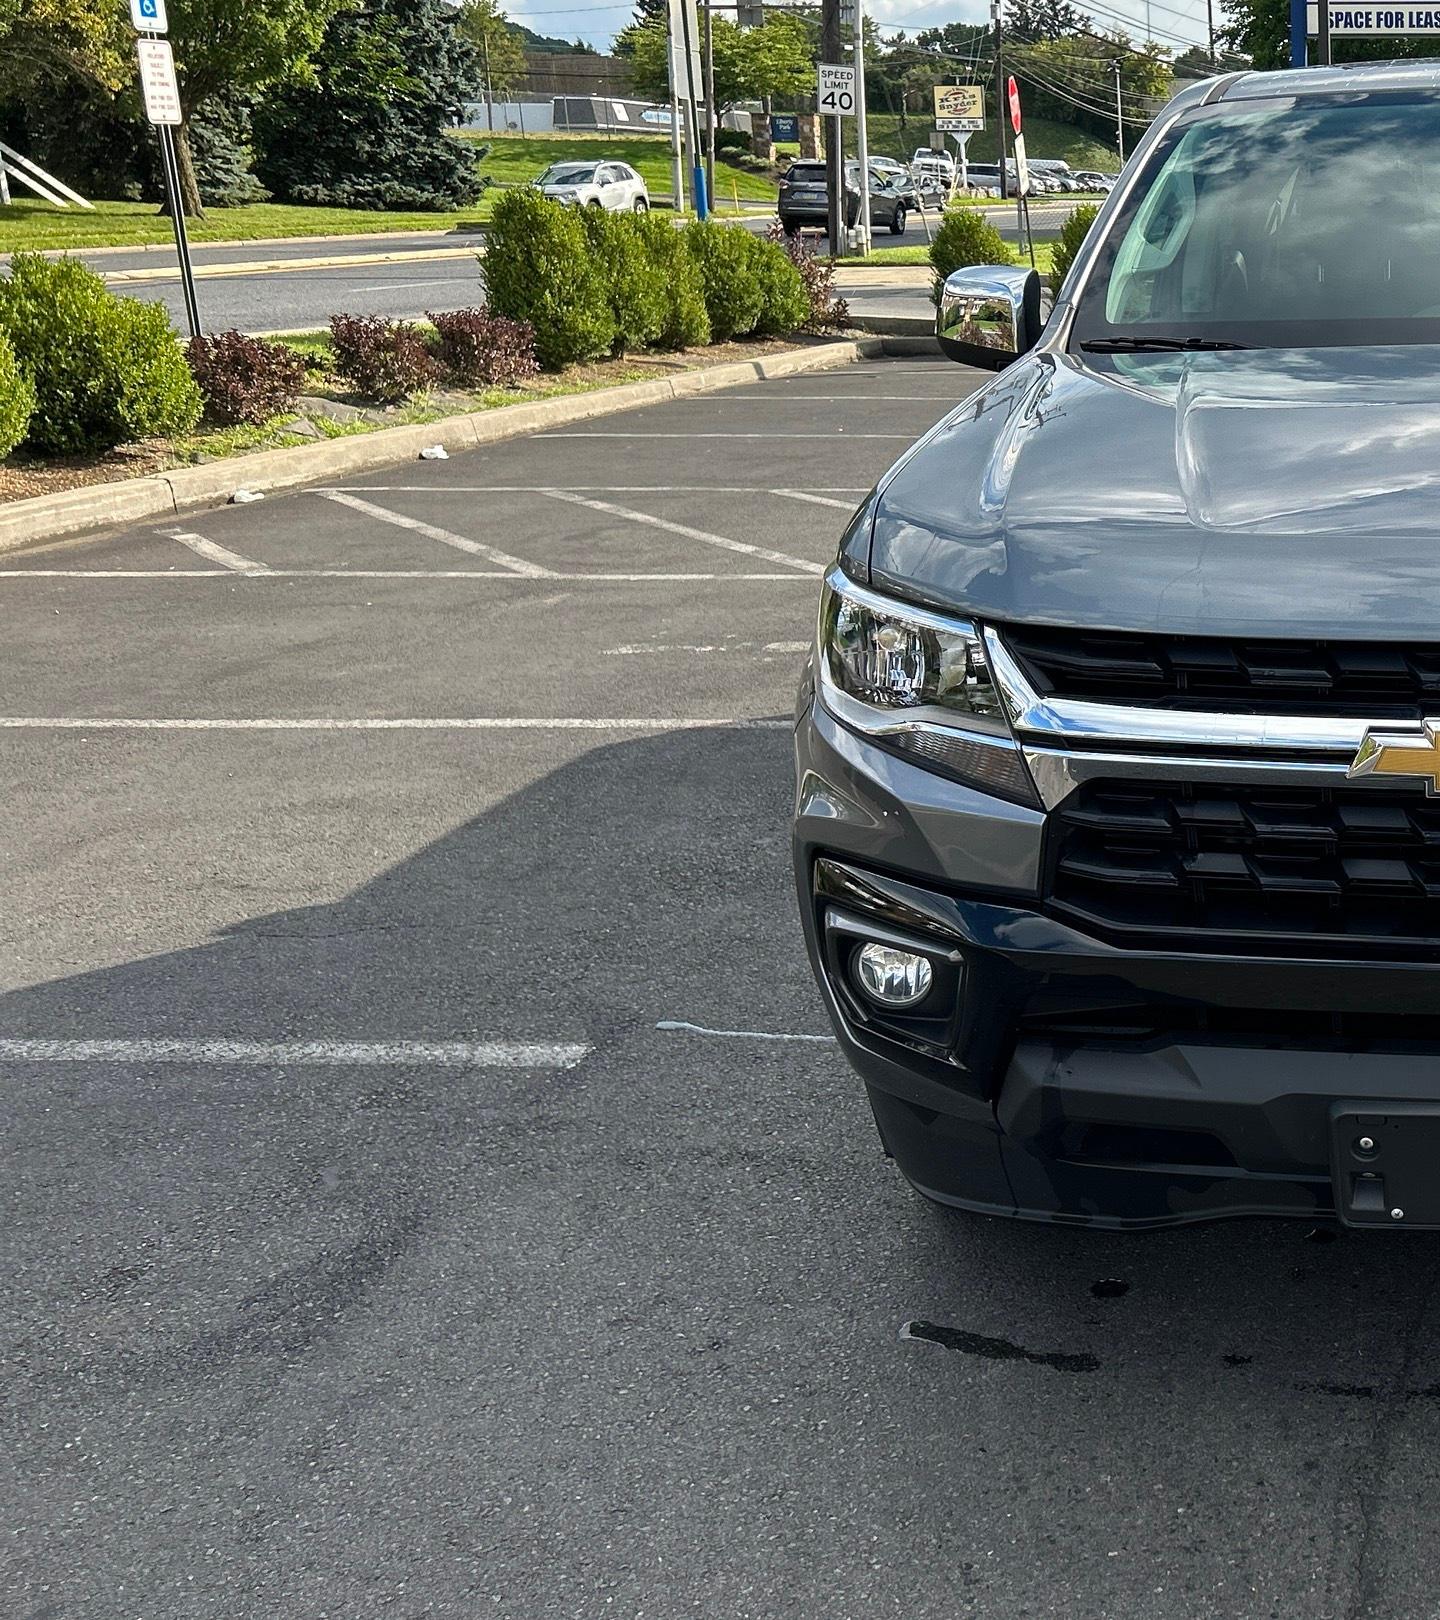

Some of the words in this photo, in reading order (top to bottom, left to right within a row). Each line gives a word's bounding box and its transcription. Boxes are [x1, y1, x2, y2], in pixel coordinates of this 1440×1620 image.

[1329, 11, 1372, 28] SPACE
[1376, 11, 1404, 28] FOR
[821, 70, 853, 80] SPEED
[824, 81, 849, 90] LIMIT
[821, 91, 853, 110] 40
[938, 94, 976, 103] Kris
[939, 100, 977, 111] Snyder
